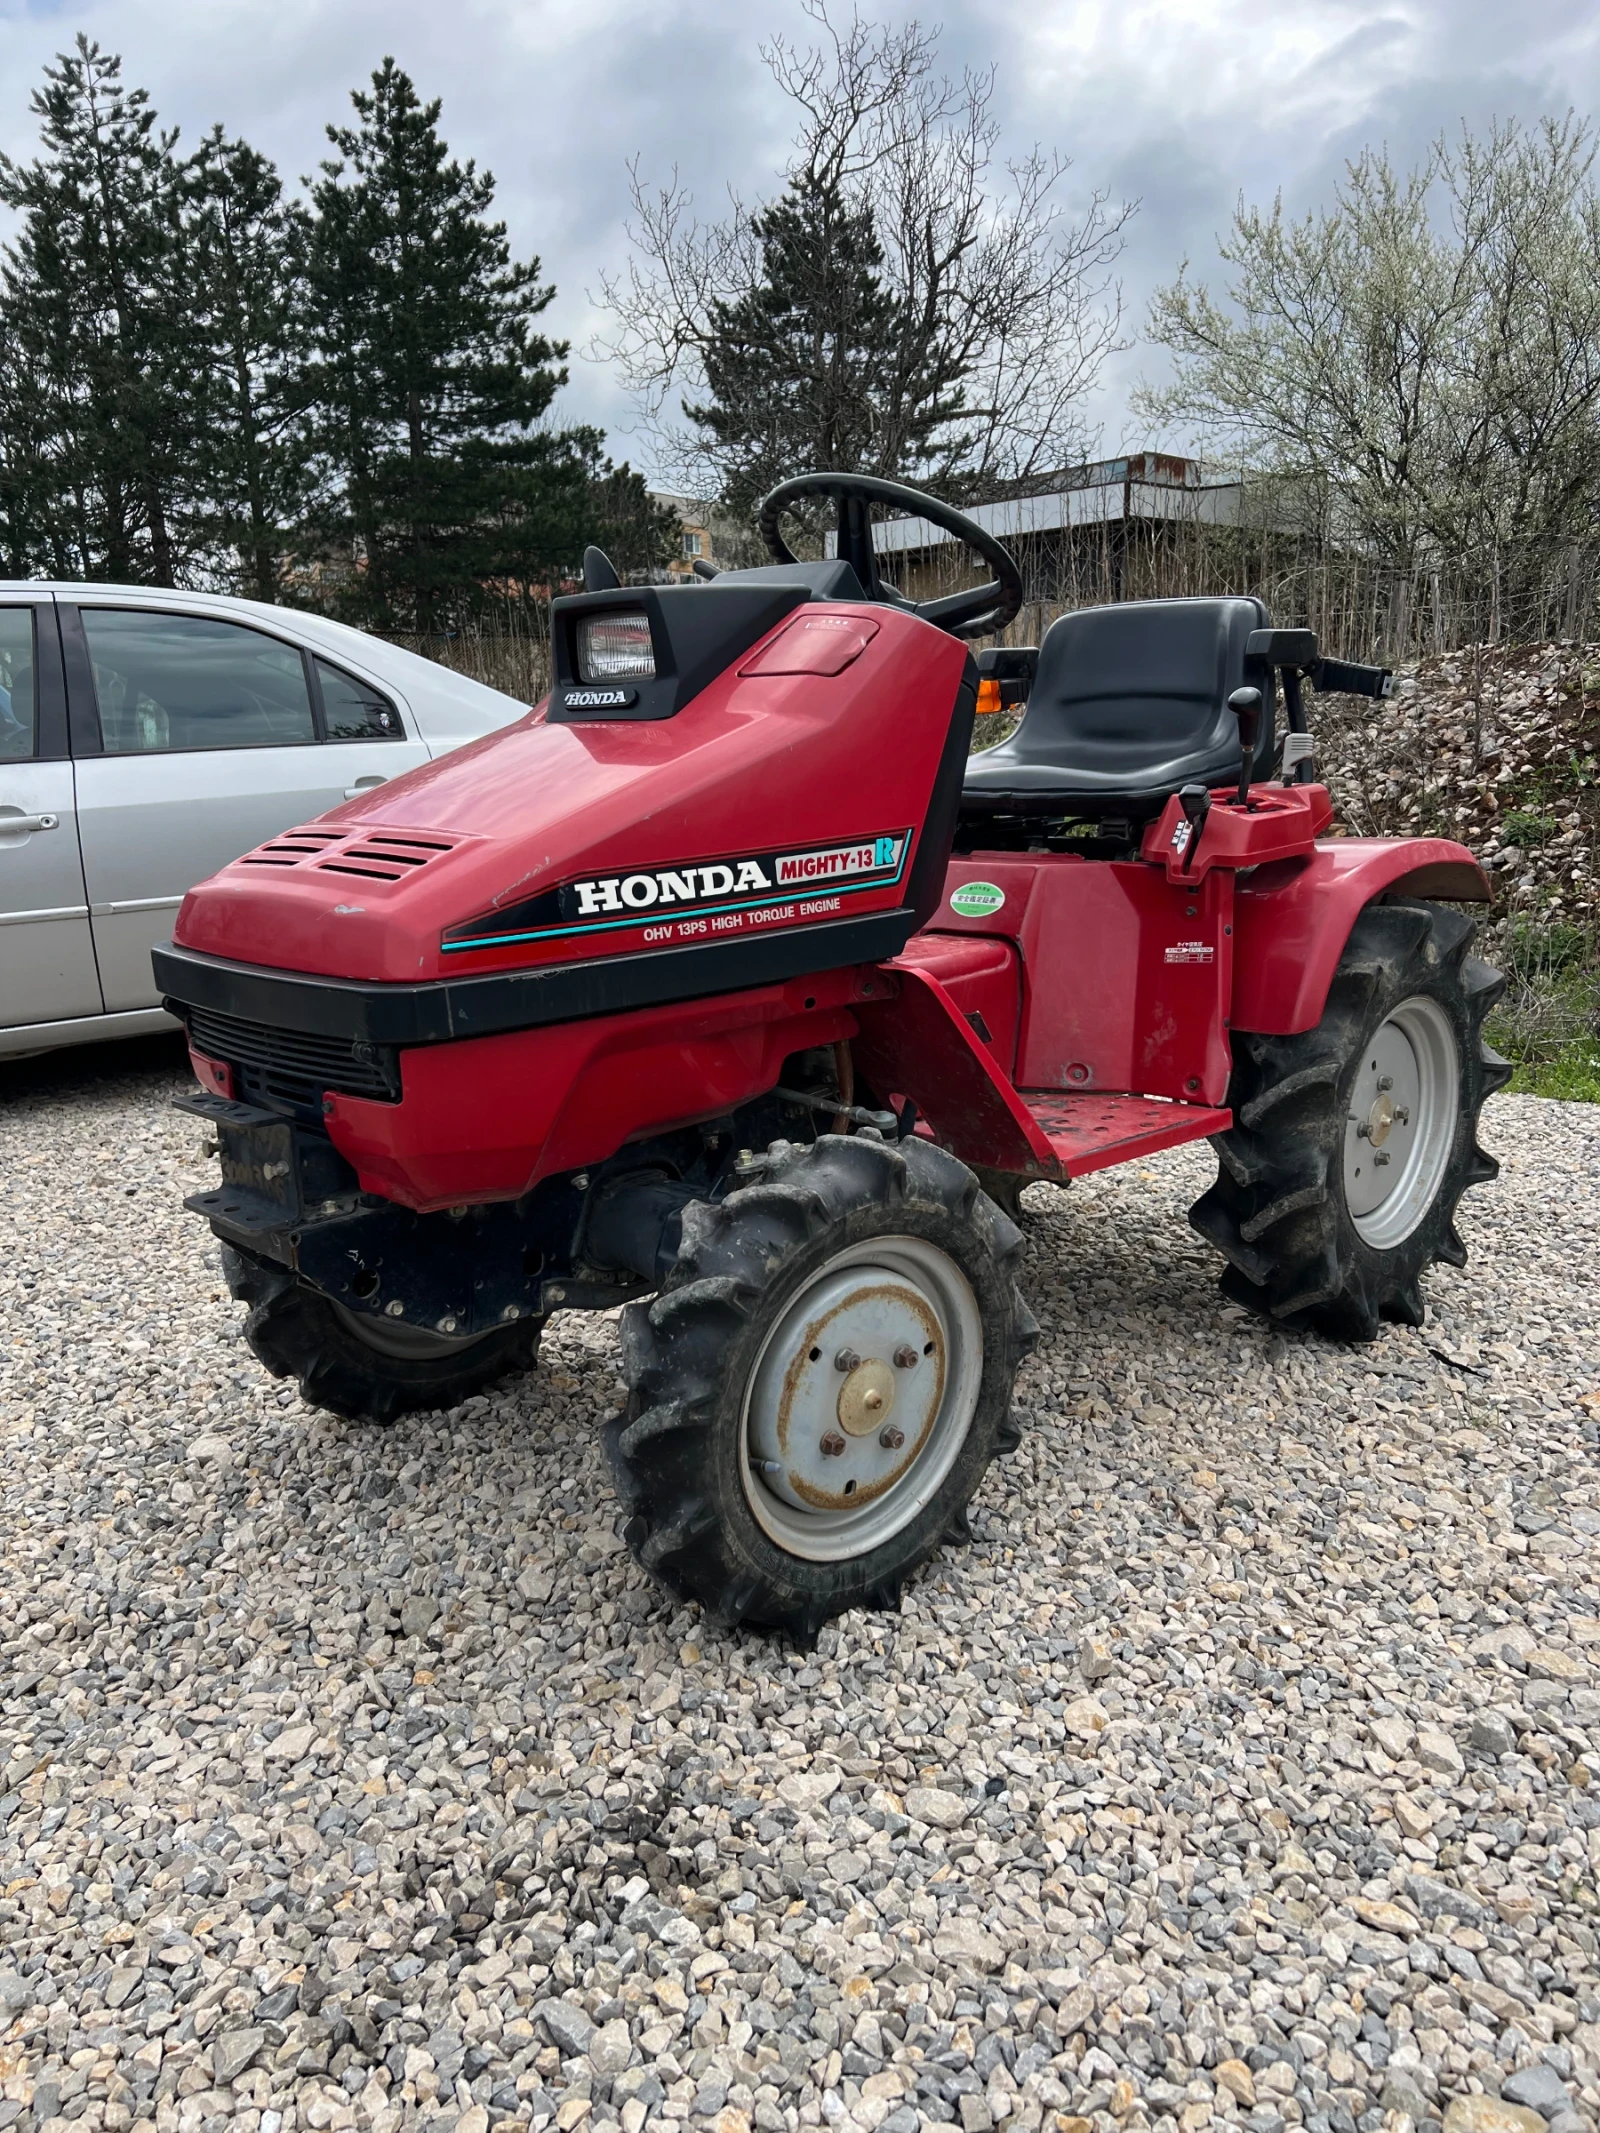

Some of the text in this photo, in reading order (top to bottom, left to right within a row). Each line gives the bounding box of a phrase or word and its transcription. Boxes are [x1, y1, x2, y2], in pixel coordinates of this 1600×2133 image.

[564, 690, 627, 706] HONDA
[574, 860, 772, 915] HONDA
[643, 897, 841, 942] OHV 13PS HIGH TORQUE ENGINE
